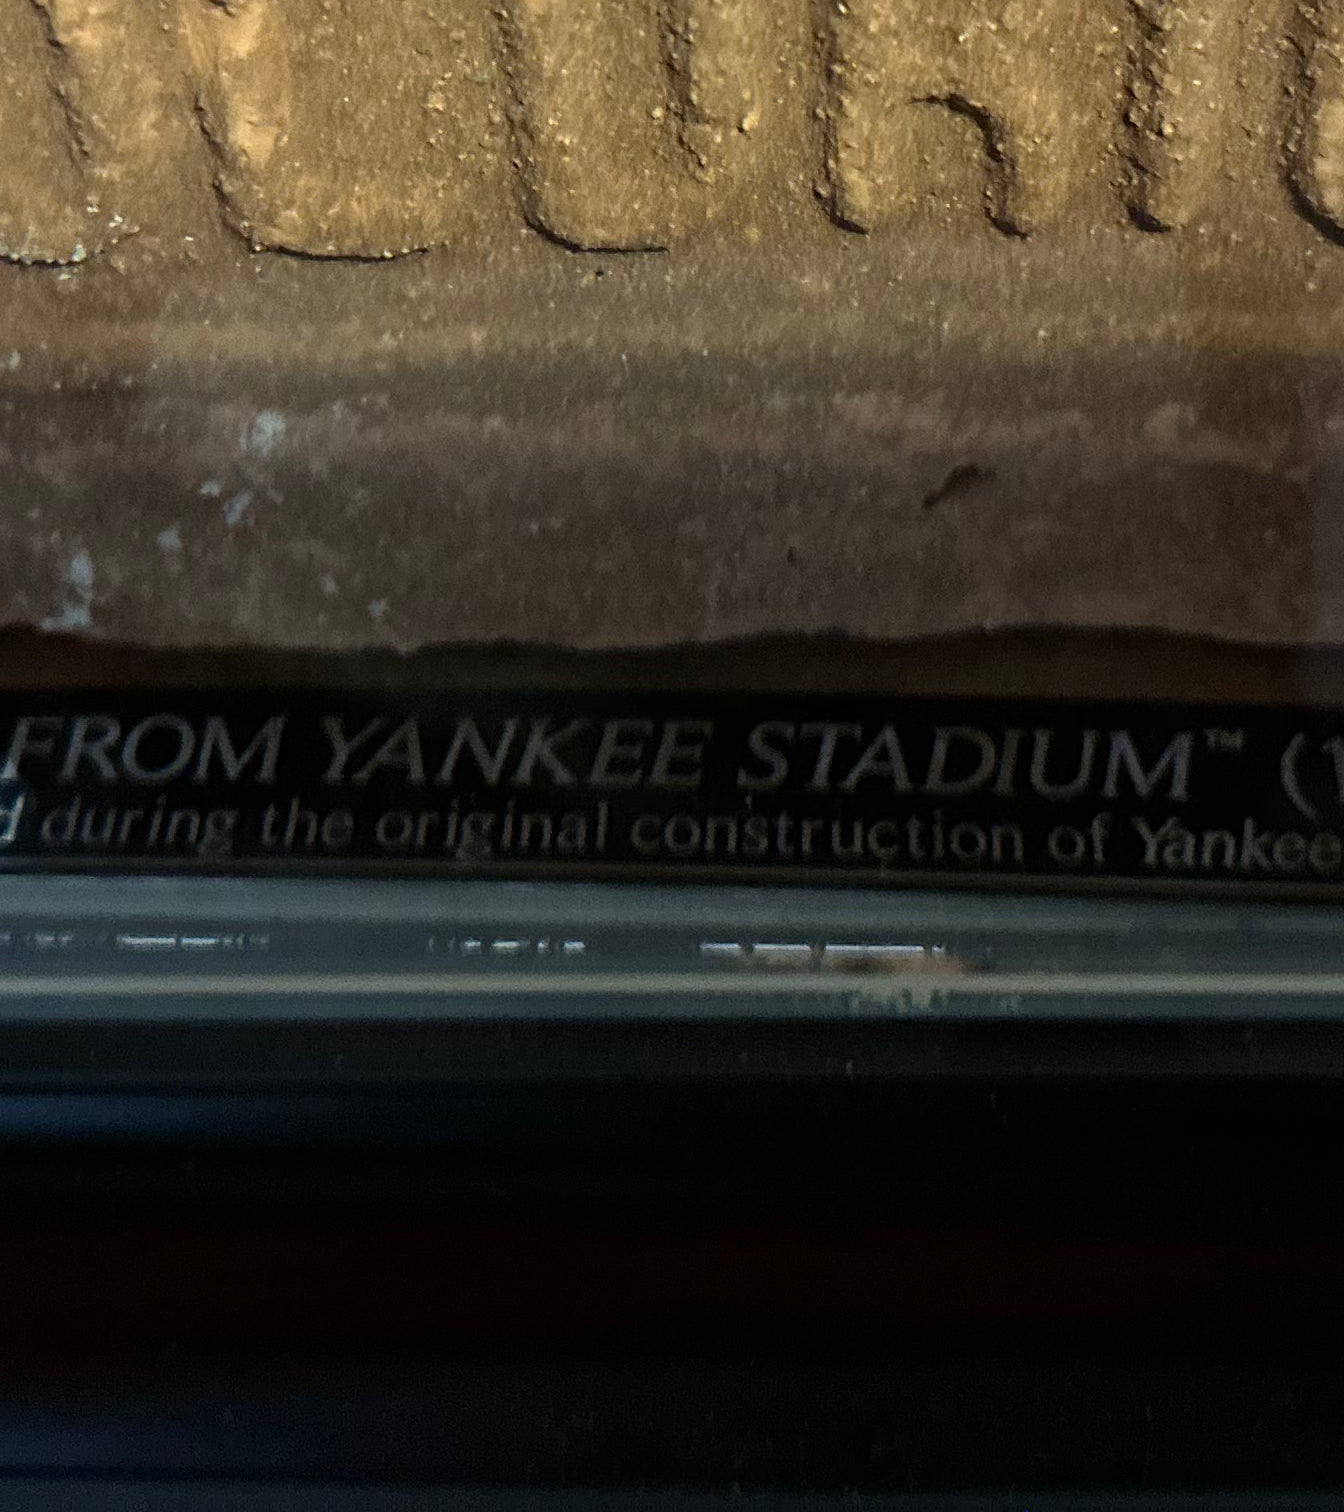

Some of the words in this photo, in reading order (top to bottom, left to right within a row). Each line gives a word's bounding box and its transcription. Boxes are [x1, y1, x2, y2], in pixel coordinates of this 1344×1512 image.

[322, 717, 706, 788] YANKEE
[40, 796, 238, 858] during
[260, 799, 355, 845] the
[374, 799, 609, 862] original
[630, 805, 1026, 860] construction
[1048, 808, 1112, 865] of
[1133, 818, 1344, 872] Yankee
